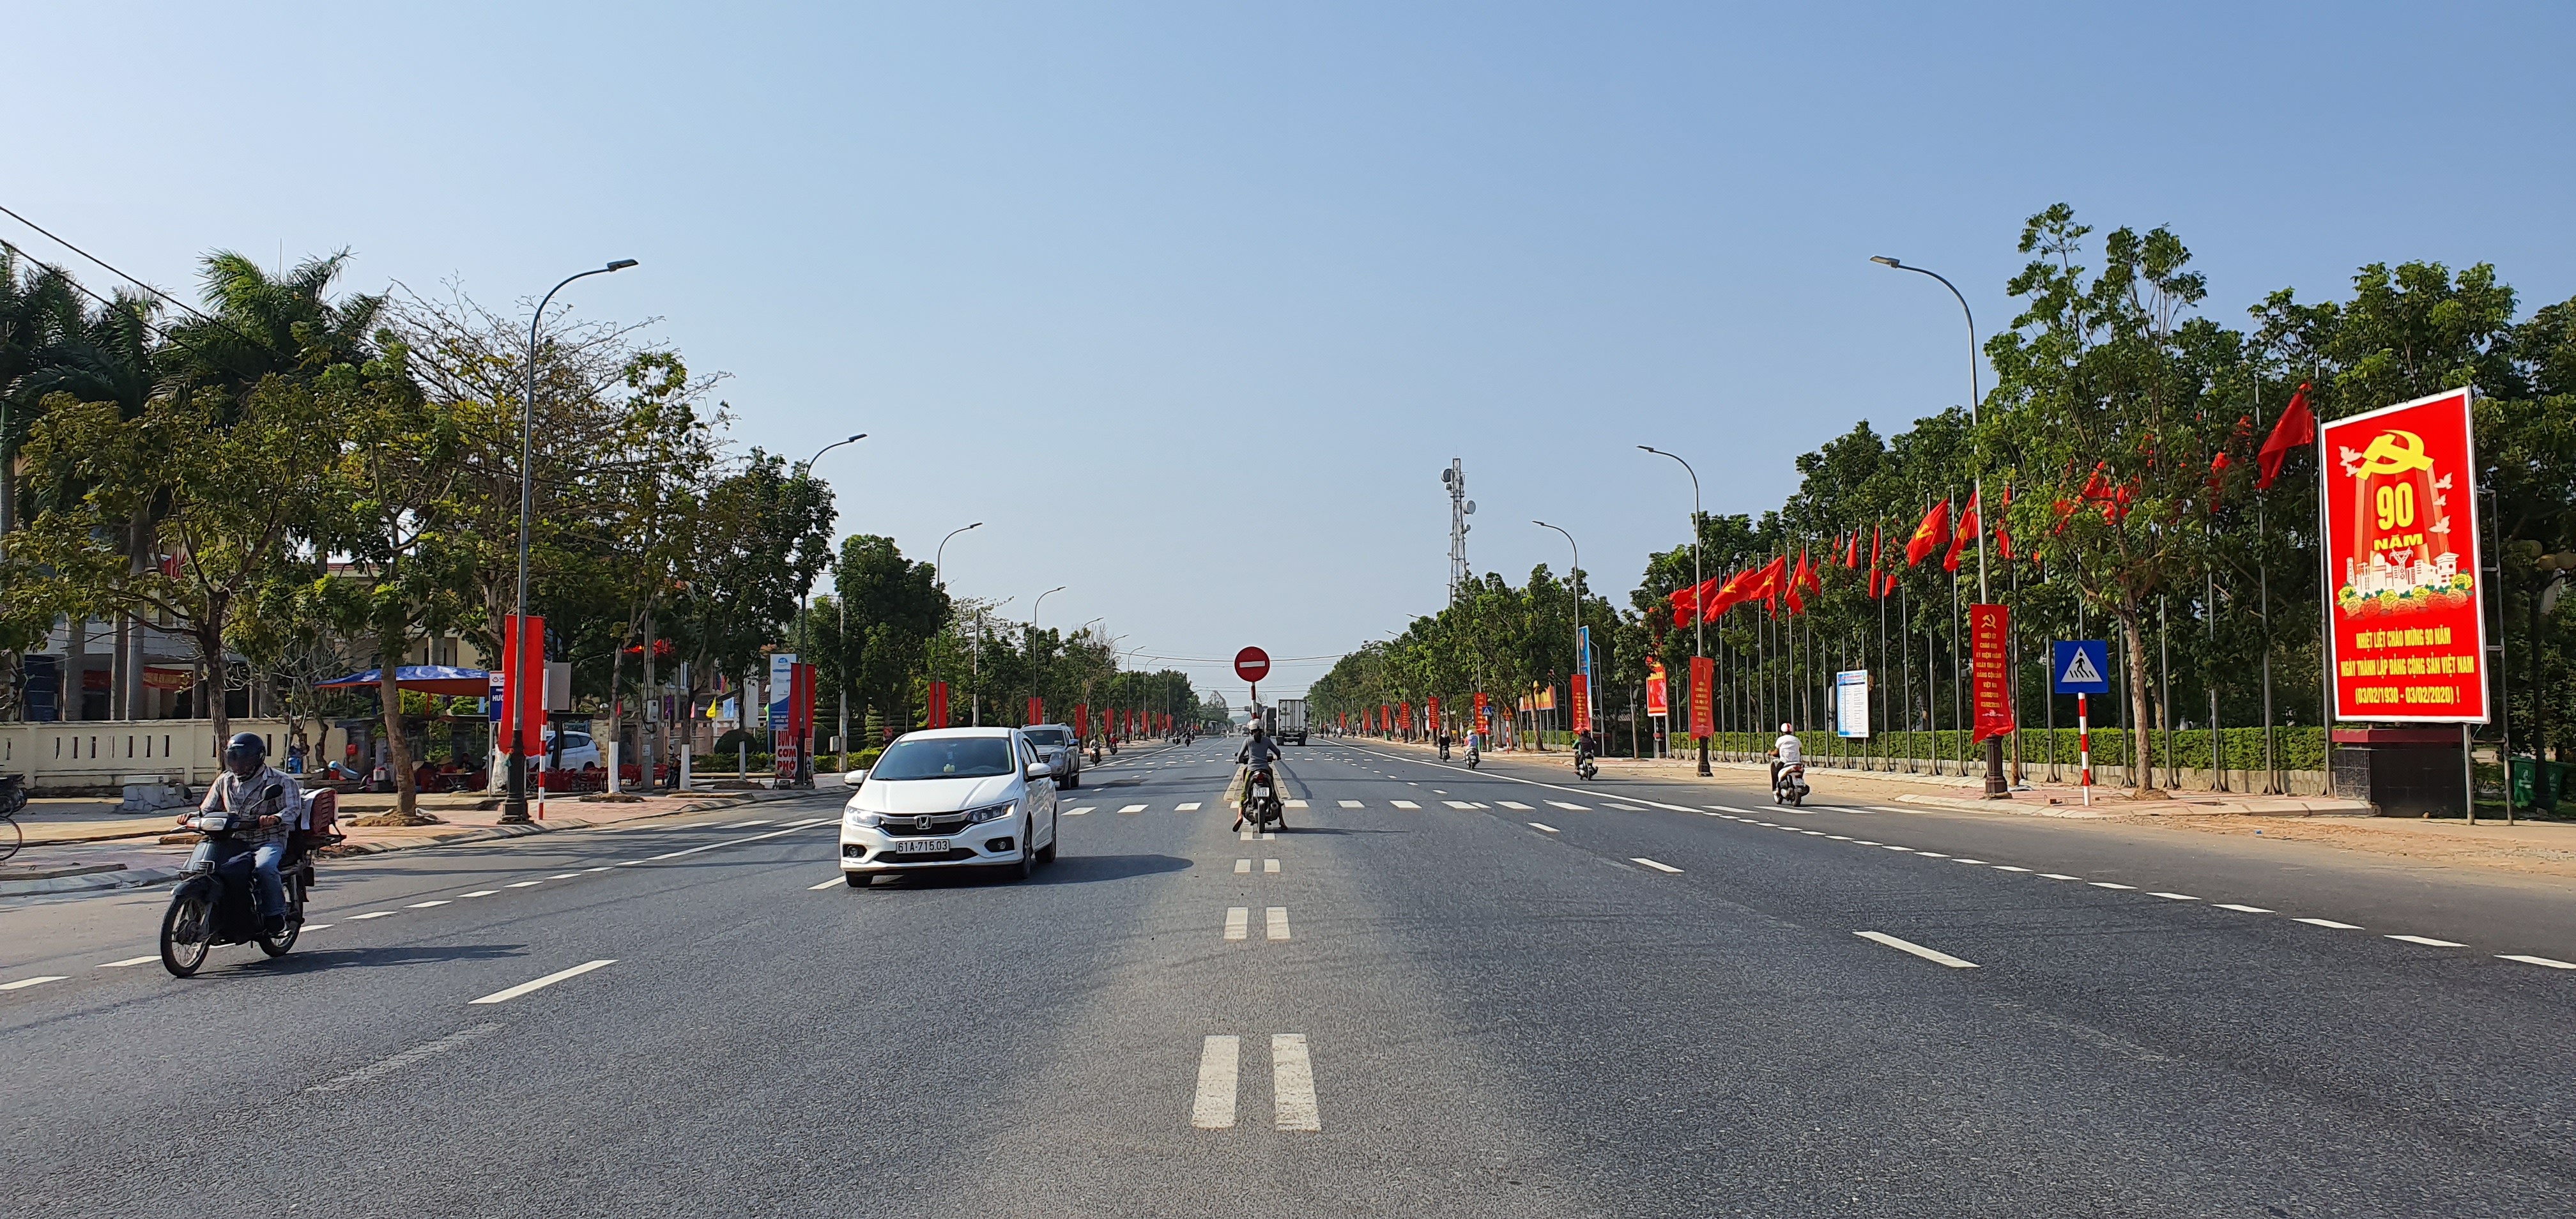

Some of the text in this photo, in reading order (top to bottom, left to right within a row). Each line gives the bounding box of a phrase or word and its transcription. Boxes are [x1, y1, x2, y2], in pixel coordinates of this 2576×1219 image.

[2377, 482, 2414, 530] 90
[2373, 533, 2423, 551] NĂM
[2356, 624, 2451, 652] NHIỆT LIỆT CHÀO MỪNG 90 NĂM
[2341, 652, 2475, 679] NGÀY THÀNH LẬP ĐẢNG CỘNG SẢN VIỆT NAM
[2355, 687, 2399, 705] (03/02/1930
[2405, 686, 2454, 705] 03/02/2020)
[898, 840, 947, 852] 61A-715.03
